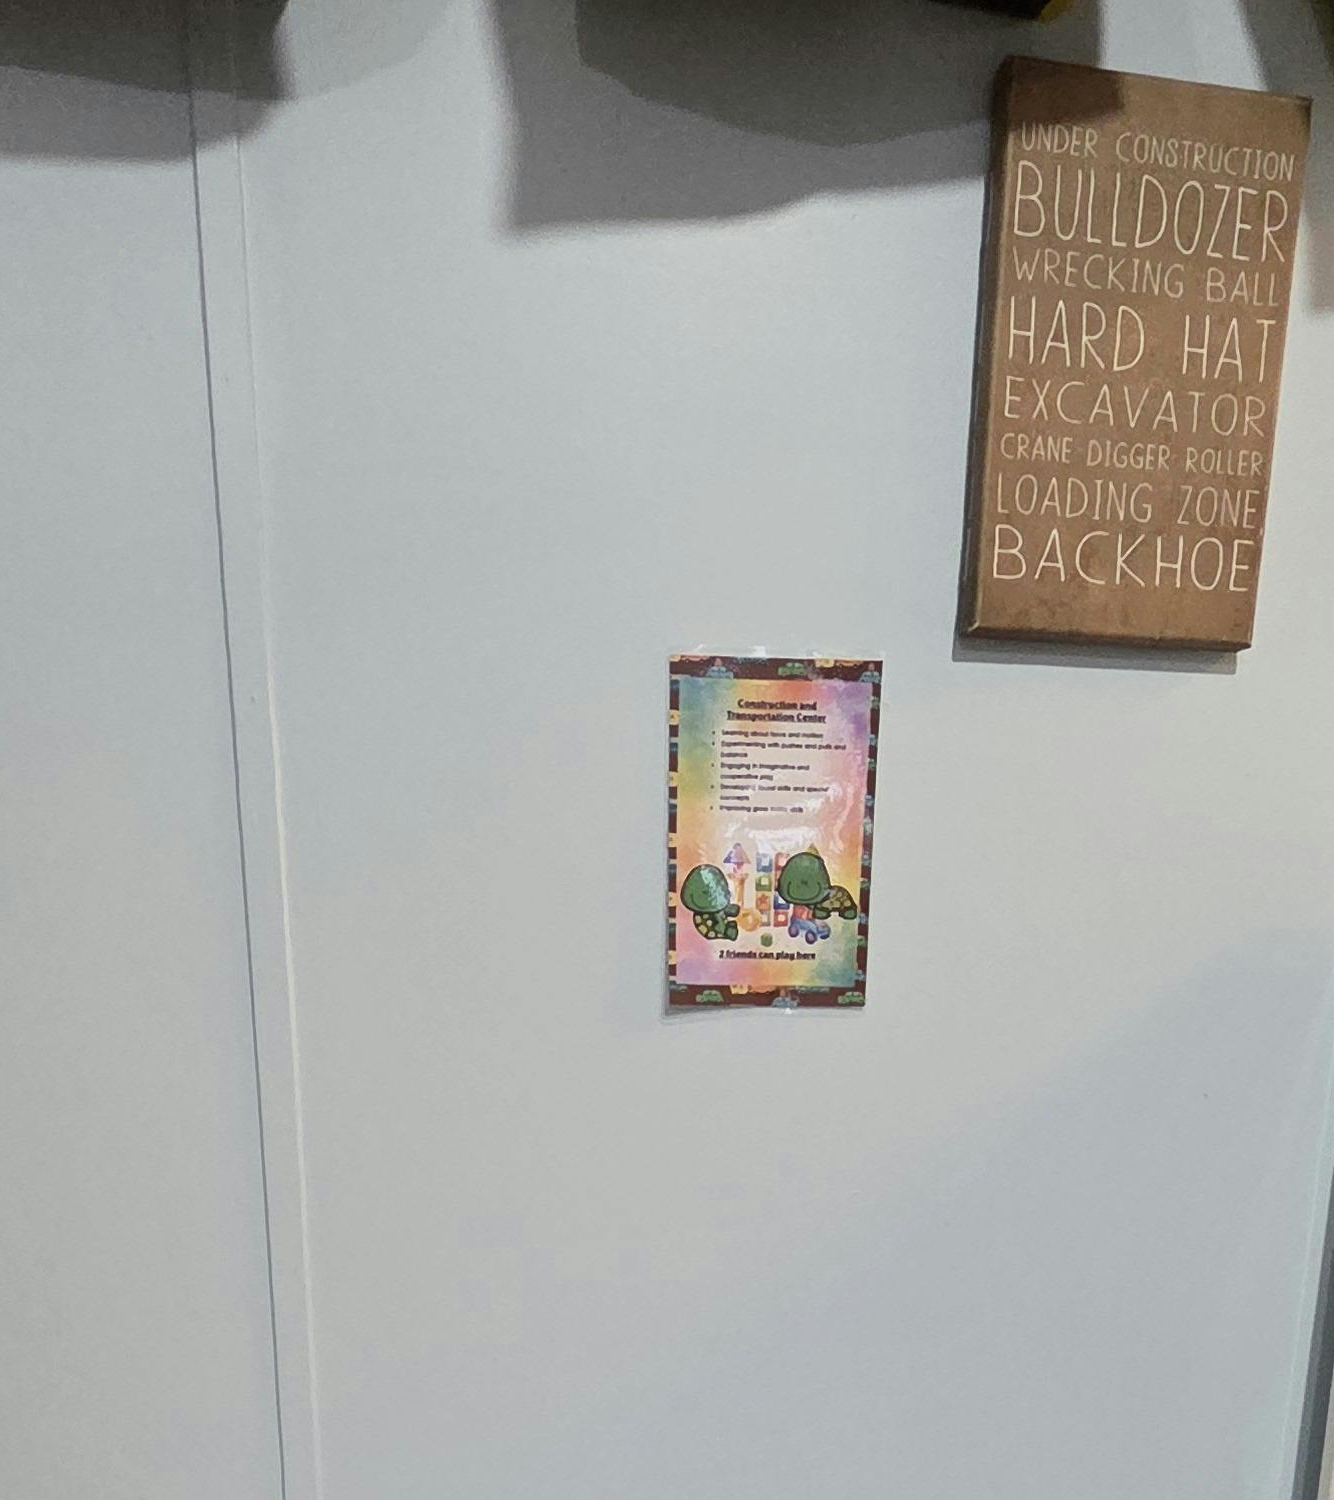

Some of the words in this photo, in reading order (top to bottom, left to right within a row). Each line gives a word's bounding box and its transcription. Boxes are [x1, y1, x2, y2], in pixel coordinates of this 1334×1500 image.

[1020, 122, 1099, 158] UNDER
[1116, 130, 1295, 182] CONSTRUCTION
[1013, 159, 1289, 263] BULLDOZER
[1012, 245, 1185, 299] WRECKING
[1206, 267, 1280, 307] BALL
[1007, 295, 1146, 372] HARD
[1181, 314, 1276, 384] HAT
[1003, 374, 1266, 438] EXCAVATOR
[1000, 432, 1073, 464] CRANE
[1086, 439, 1171, 471] DIGGER
[1185, 446, 1264, 477] ROLLER
[996, 472, 1154, 524] LOADING
[1177, 485, 1261, 530] ZONE
[992, 523, 1255, 593] BACKHOE
[727, 710, 795, 722] Transportation
[796, 713, 827, 724] Center
[737, 699, 798, 710] Construction
[799, 701, 817, 711] and
[719, 950, 724, 958] 2
[726, 950, 757, 959] friends
[775, 951, 795, 961] play
[796, 952, 816, 960] here
